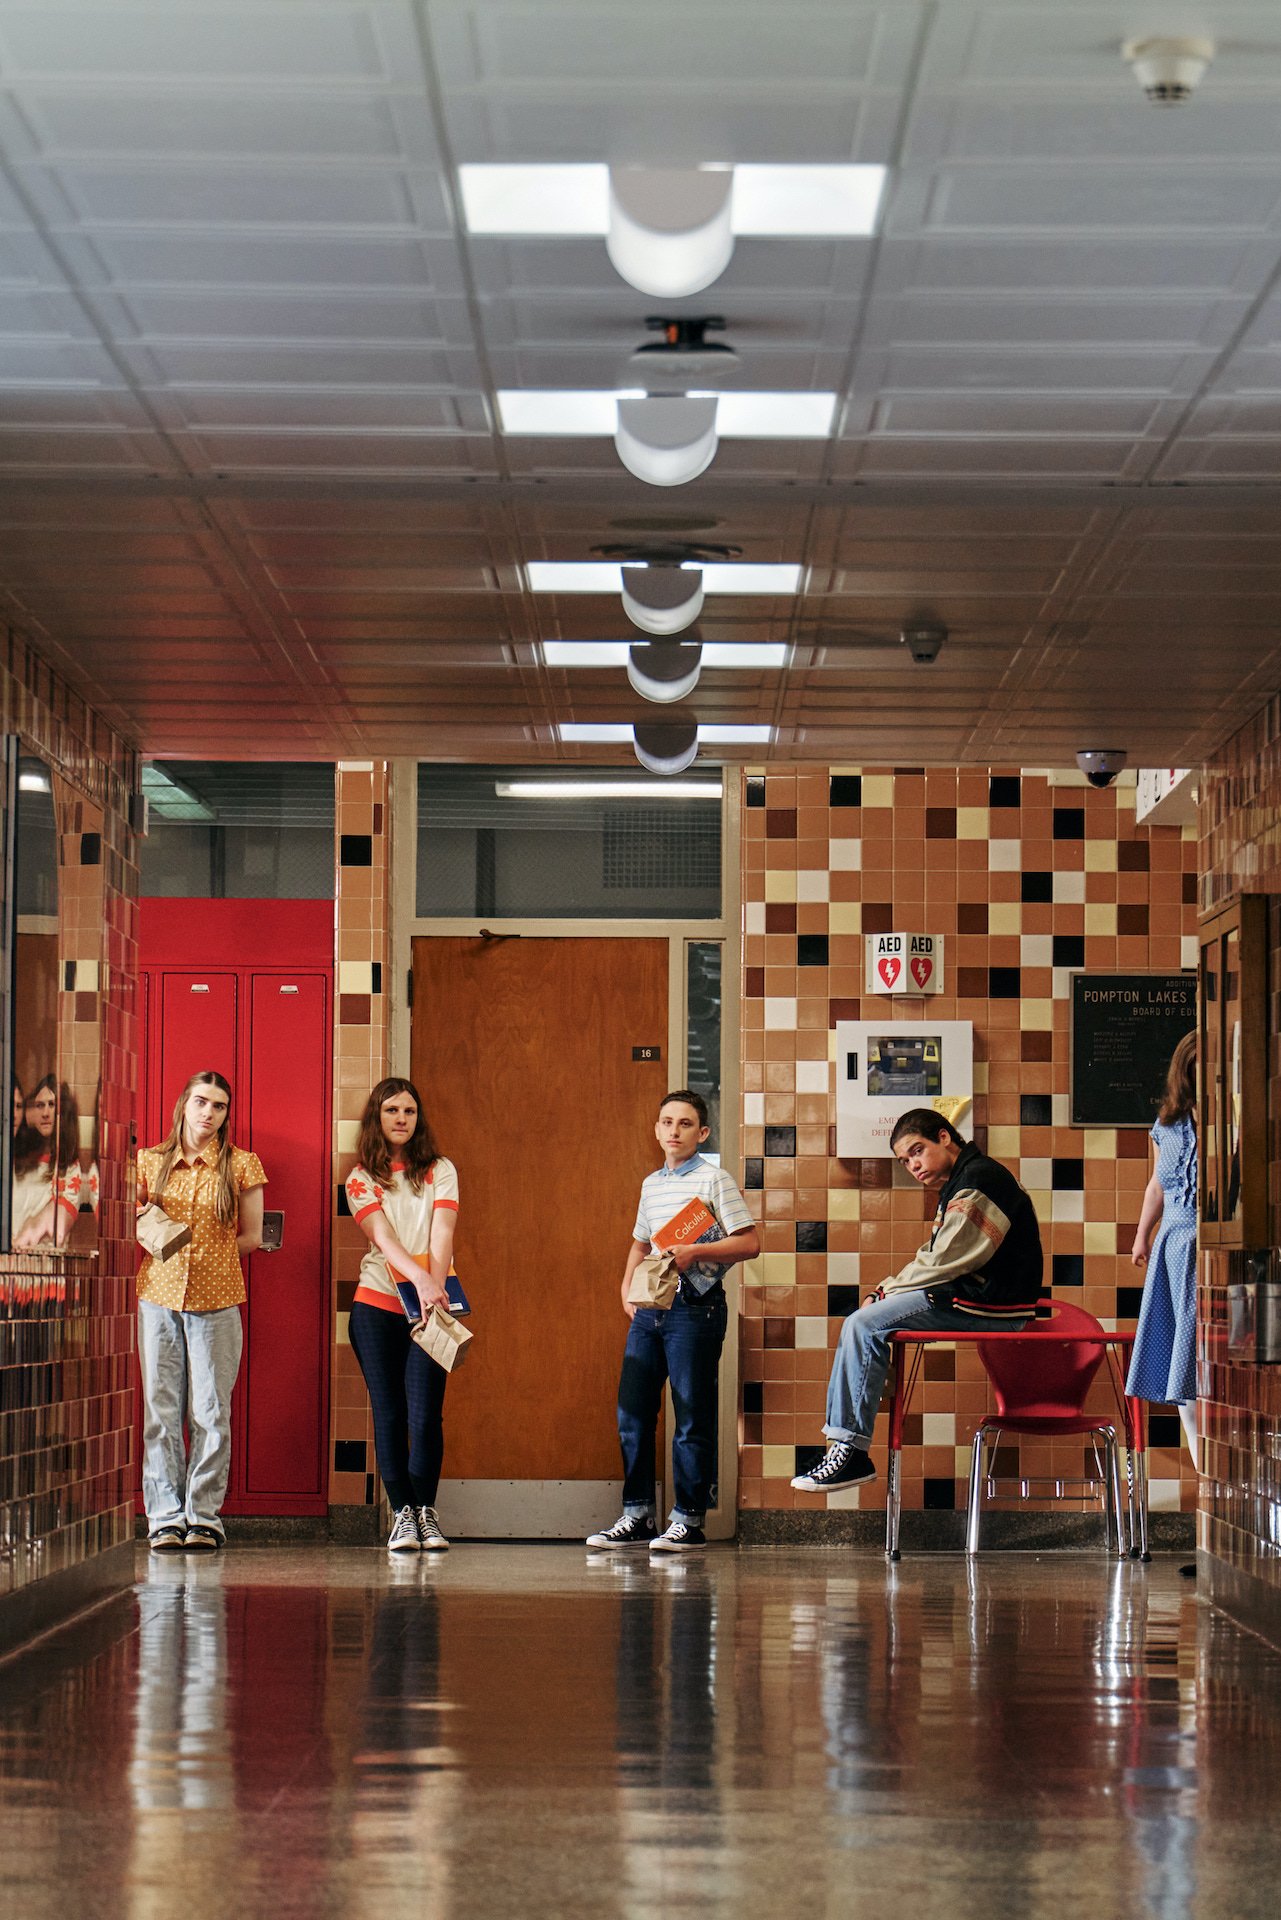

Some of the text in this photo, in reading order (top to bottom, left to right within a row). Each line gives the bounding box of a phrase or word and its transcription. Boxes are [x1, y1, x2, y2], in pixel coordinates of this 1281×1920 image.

[878, 937, 901, 952] AED
[910, 936, 933, 952] AED
[1084, 990, 1187, 1003] POMPTON LAKES
[1132, 1007, 1161, 1016] BOARD
[1164, 1007, 1176, 1016] OF
[641, 1049, 652, 1058] 16
[674, 1209, 708, 1240] Calculus
